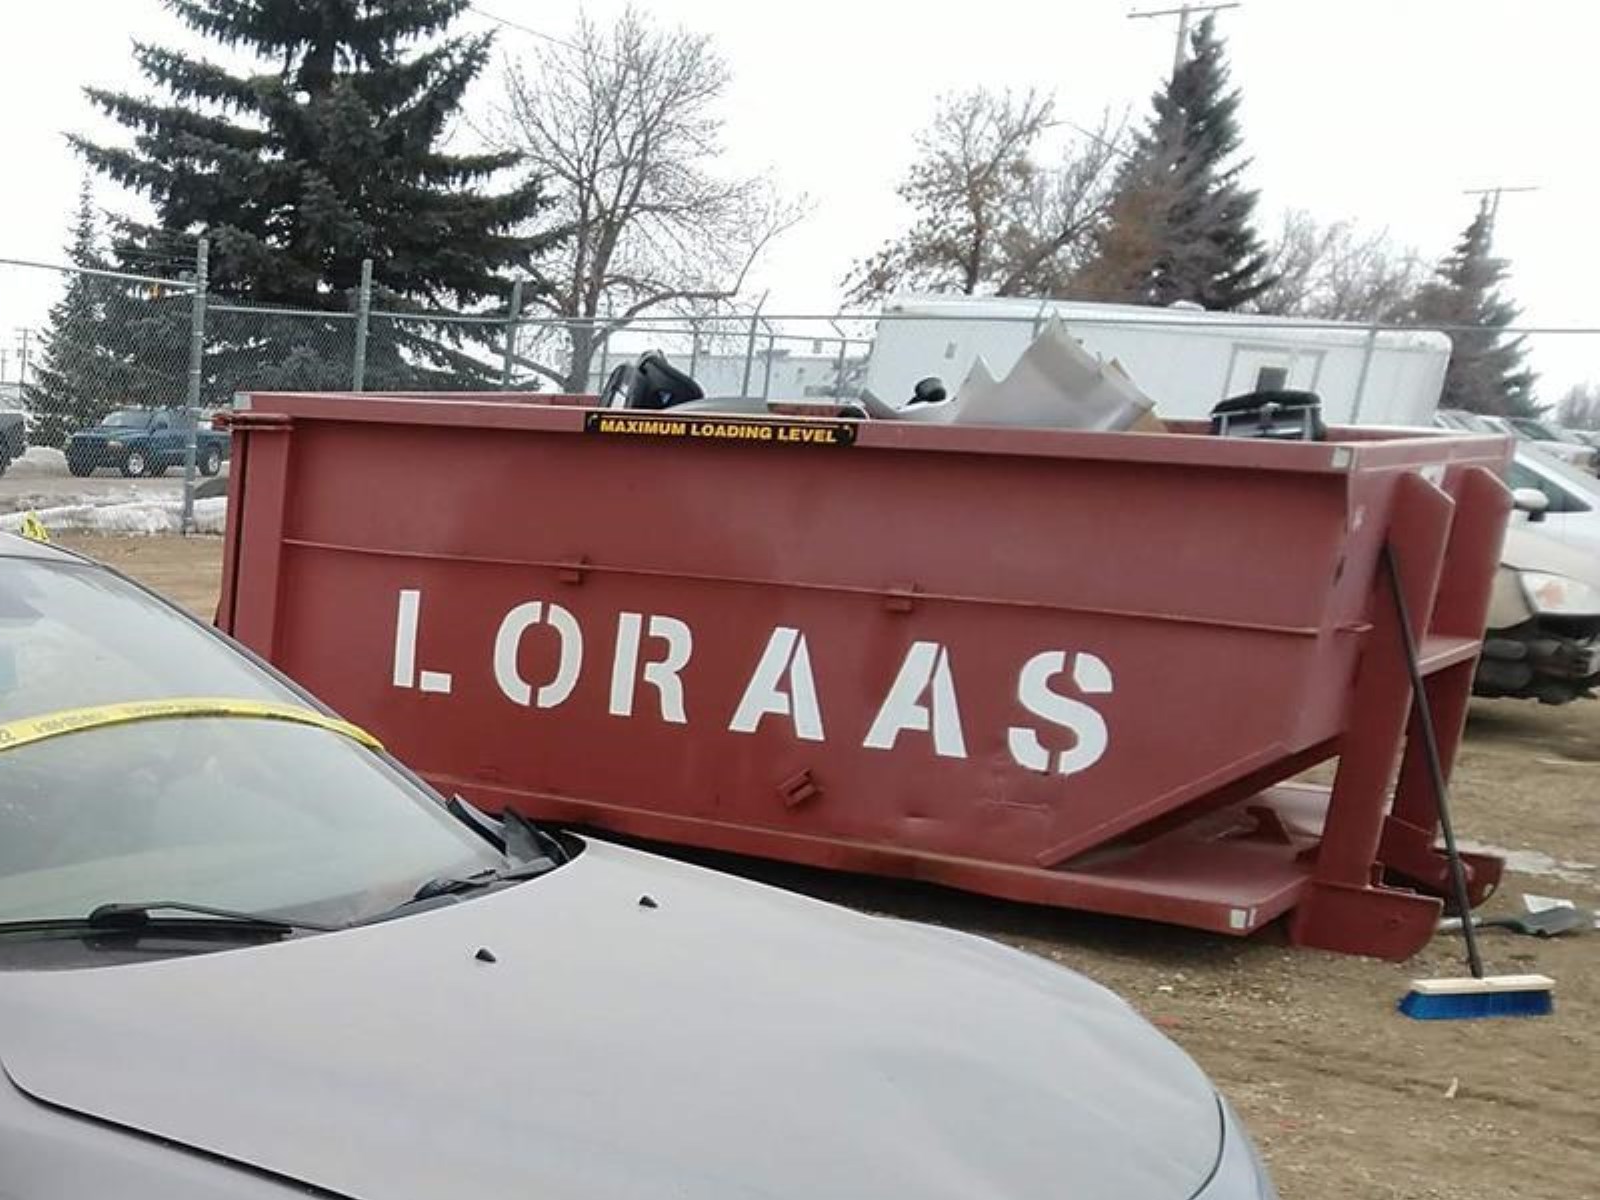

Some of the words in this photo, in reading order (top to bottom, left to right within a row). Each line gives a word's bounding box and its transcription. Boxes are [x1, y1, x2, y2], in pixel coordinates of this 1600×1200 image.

[600, 419, 686, 435] MAXIMUM
[690, 424, 773, 440] LOADING
[777, 427, 838, 443] LEVEL
[392, 588, 1114, 775] LORAAS
